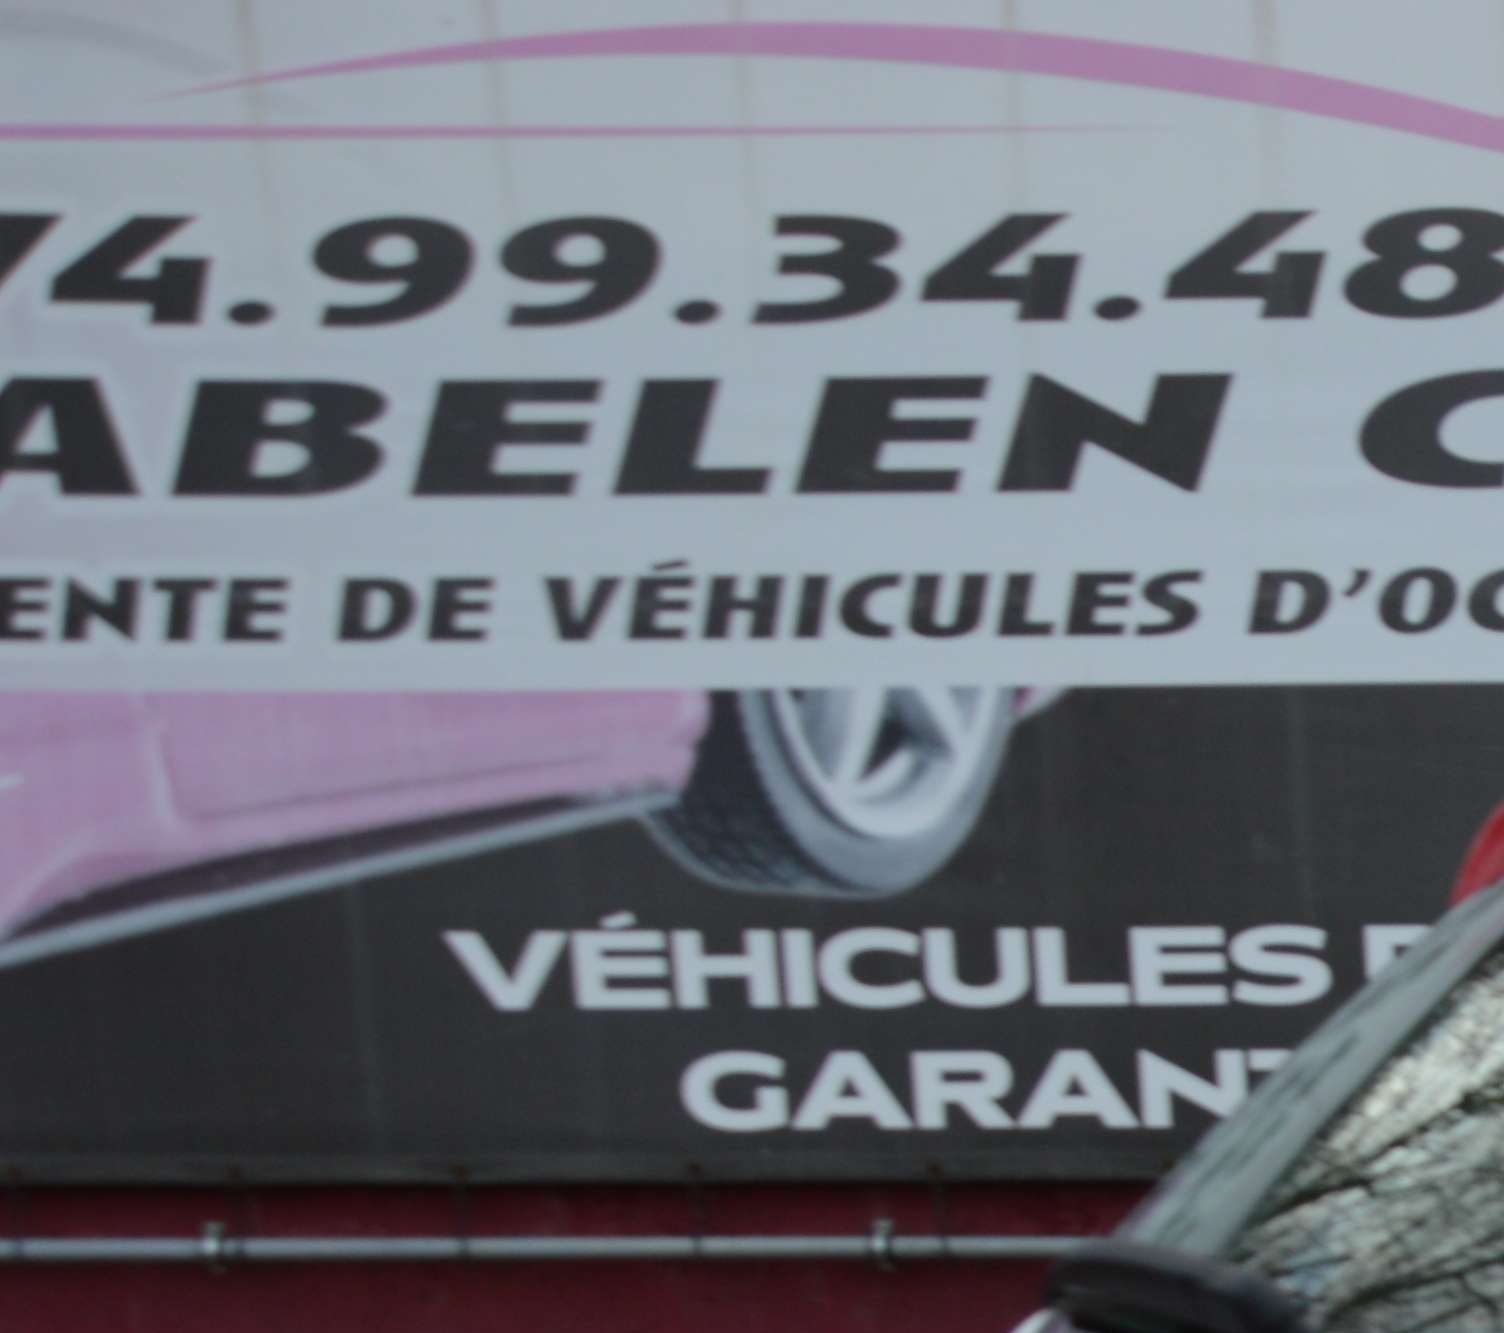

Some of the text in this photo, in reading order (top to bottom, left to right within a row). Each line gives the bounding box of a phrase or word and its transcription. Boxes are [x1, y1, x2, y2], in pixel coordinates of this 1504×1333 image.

[334, 576, 496, 643] DE
[542, 559, 1204, 641] VÉHICULES
[440, 910, 1335, 1011] VÉHICULES
